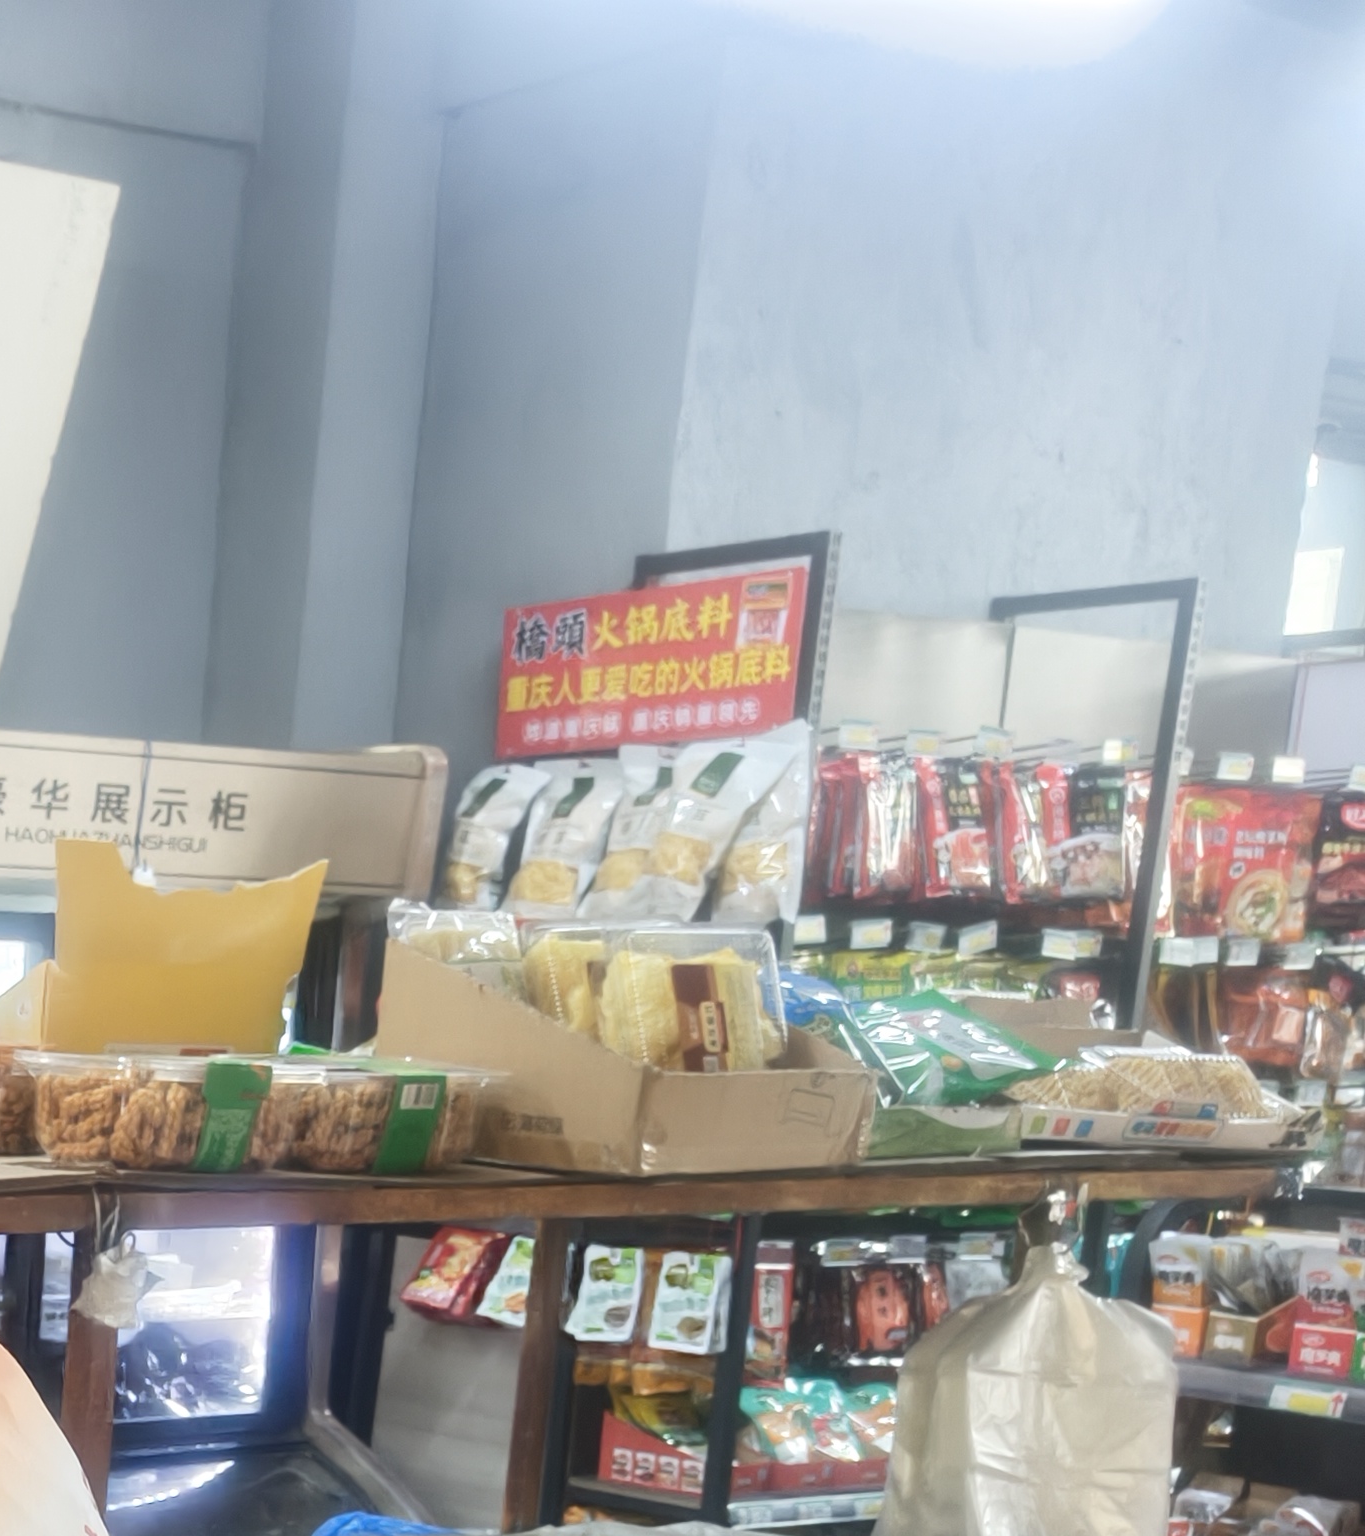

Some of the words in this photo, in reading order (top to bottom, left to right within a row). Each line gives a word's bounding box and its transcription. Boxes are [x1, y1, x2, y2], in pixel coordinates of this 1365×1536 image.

[592, 591, 733, 652] 火锅底料
[506, 644, 792, 713] 重庆人更爱吃的火锅底料
